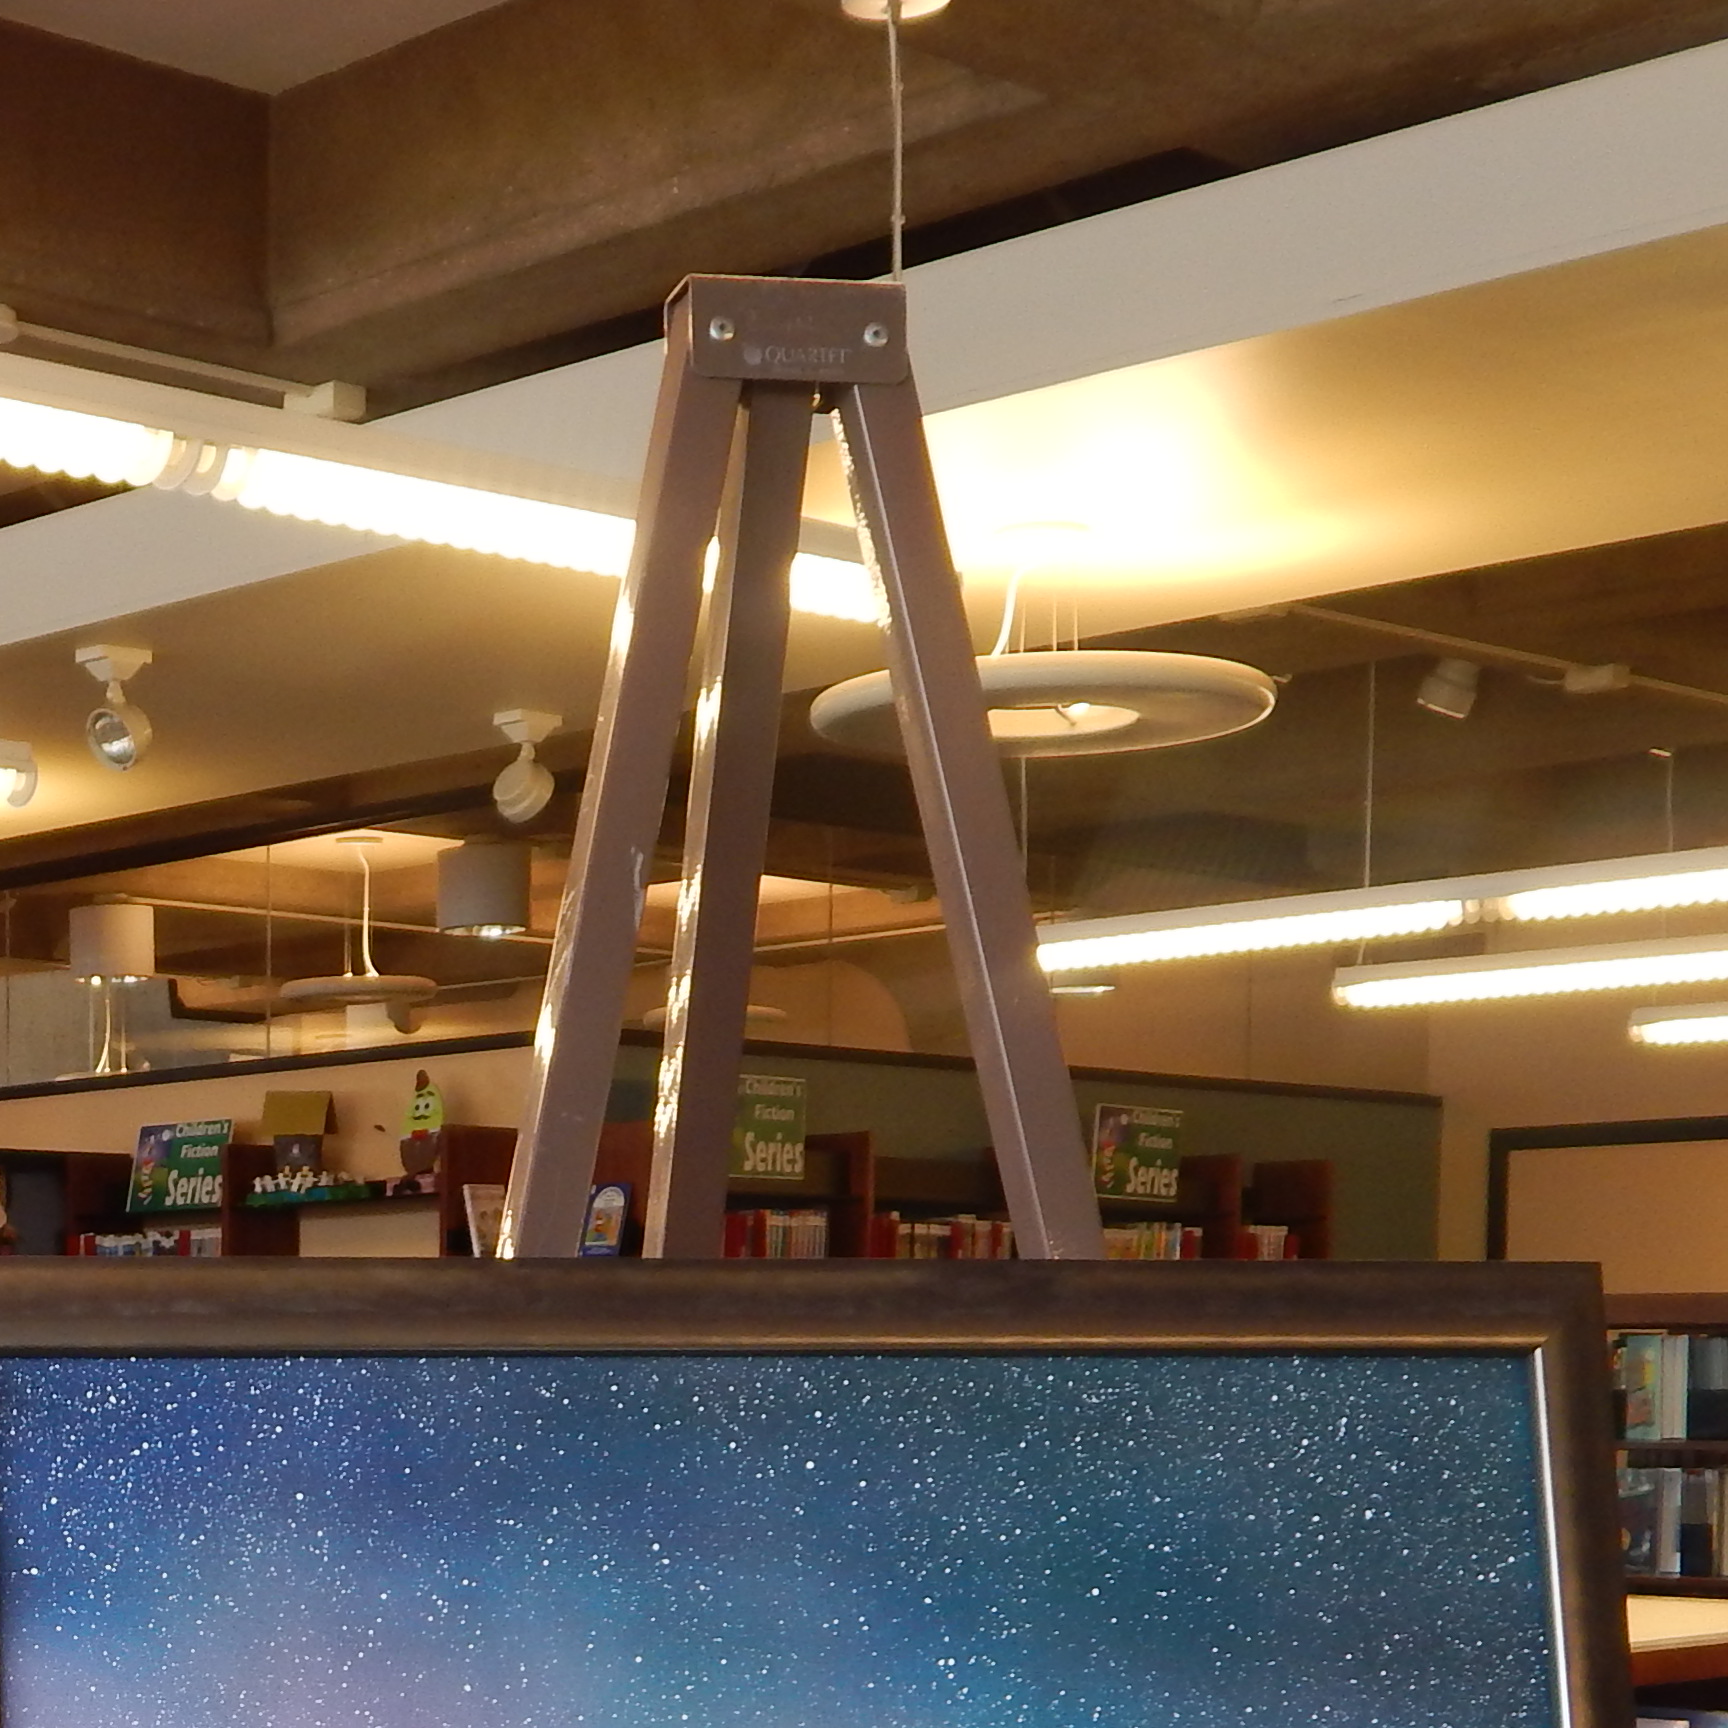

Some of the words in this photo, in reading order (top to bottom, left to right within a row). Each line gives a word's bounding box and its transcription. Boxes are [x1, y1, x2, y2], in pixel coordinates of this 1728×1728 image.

[754, 1104, 795, 1120] Fiction
[180, 1143, 219, 1158] Fiction
[743, 1131, 805, 1173] Series
[164, 1167, 223, 1206] Series
[1126, 1156, 1178, 1196] Series
